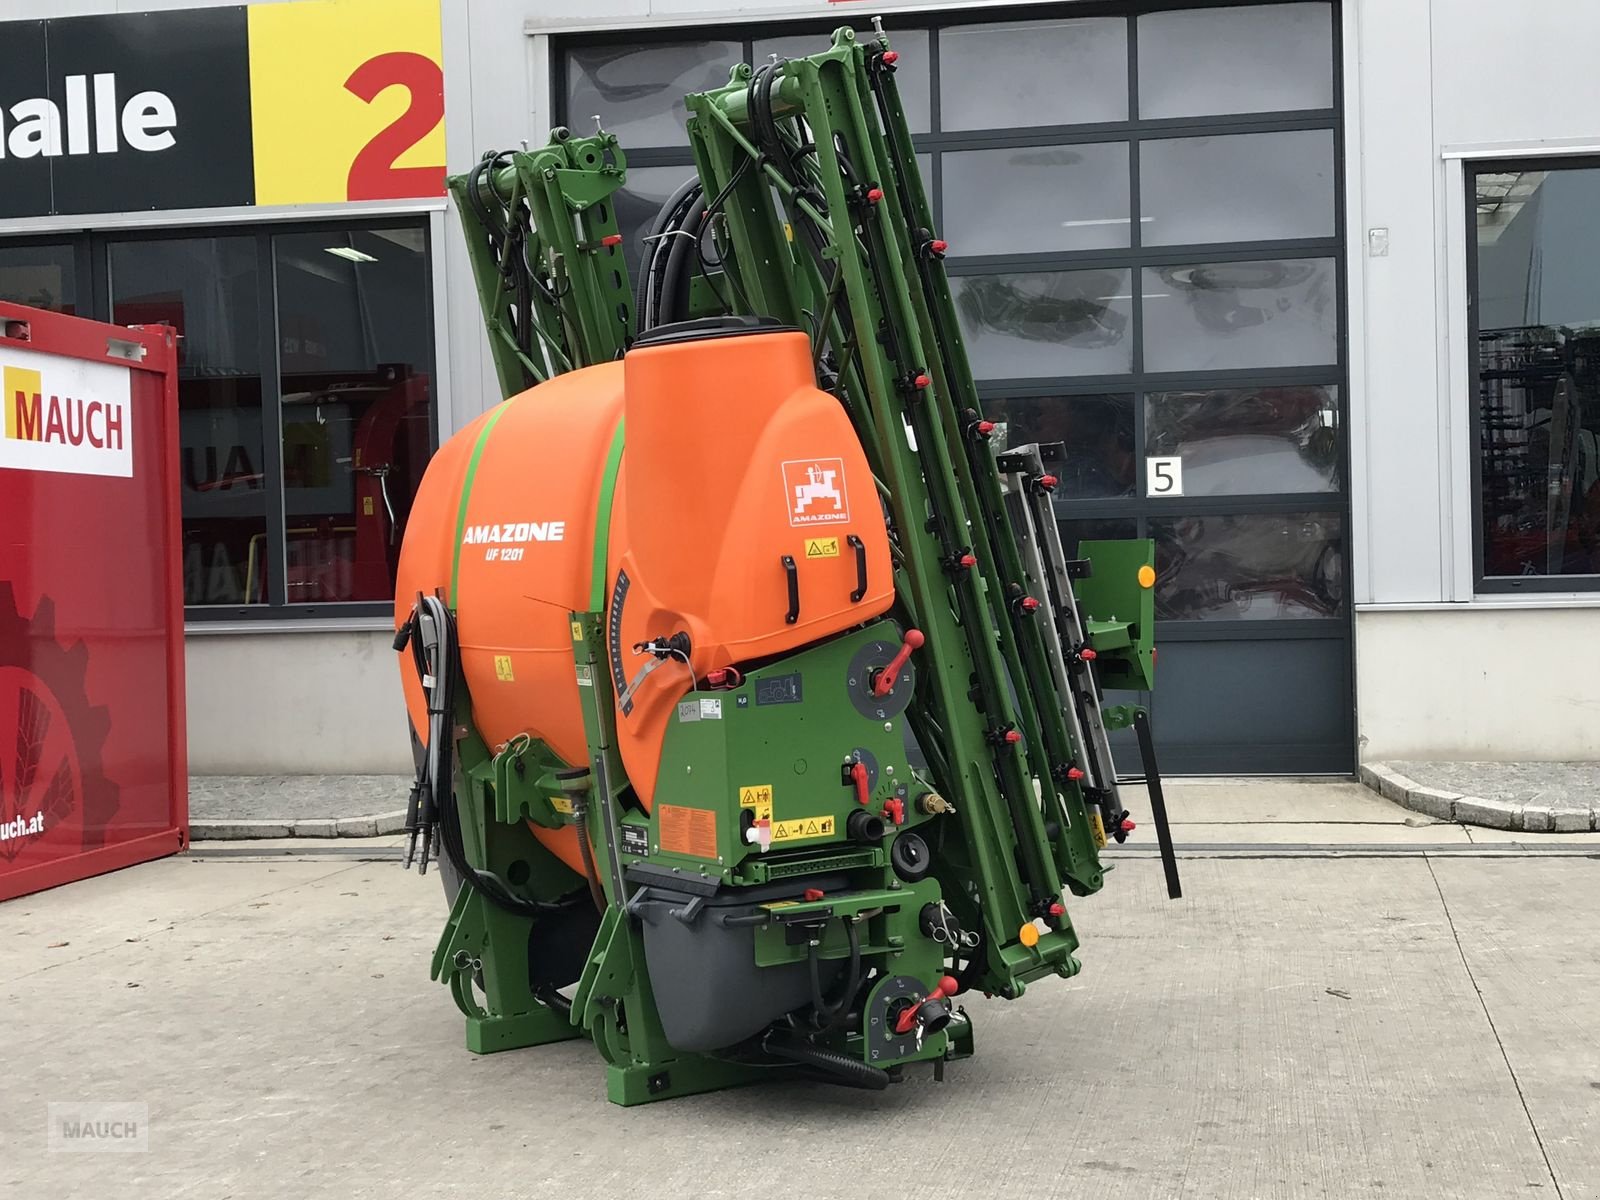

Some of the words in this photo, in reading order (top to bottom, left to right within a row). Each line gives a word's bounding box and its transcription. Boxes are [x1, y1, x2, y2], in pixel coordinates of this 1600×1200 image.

[0, 72, 177, 159] alle
[343, 52, 448, 201] 2
[16, 390, 123, 450] MAUCH
[1155, 462, 1173, 492] 5
[462, 521, 565, 544] AMAZONE
[793, 513, 847, 523] AMAZONE
[485, 547, 499, 561] UF
[500, 547, 525, 561] 1201
[0, 811, 44, 841] uch.at
